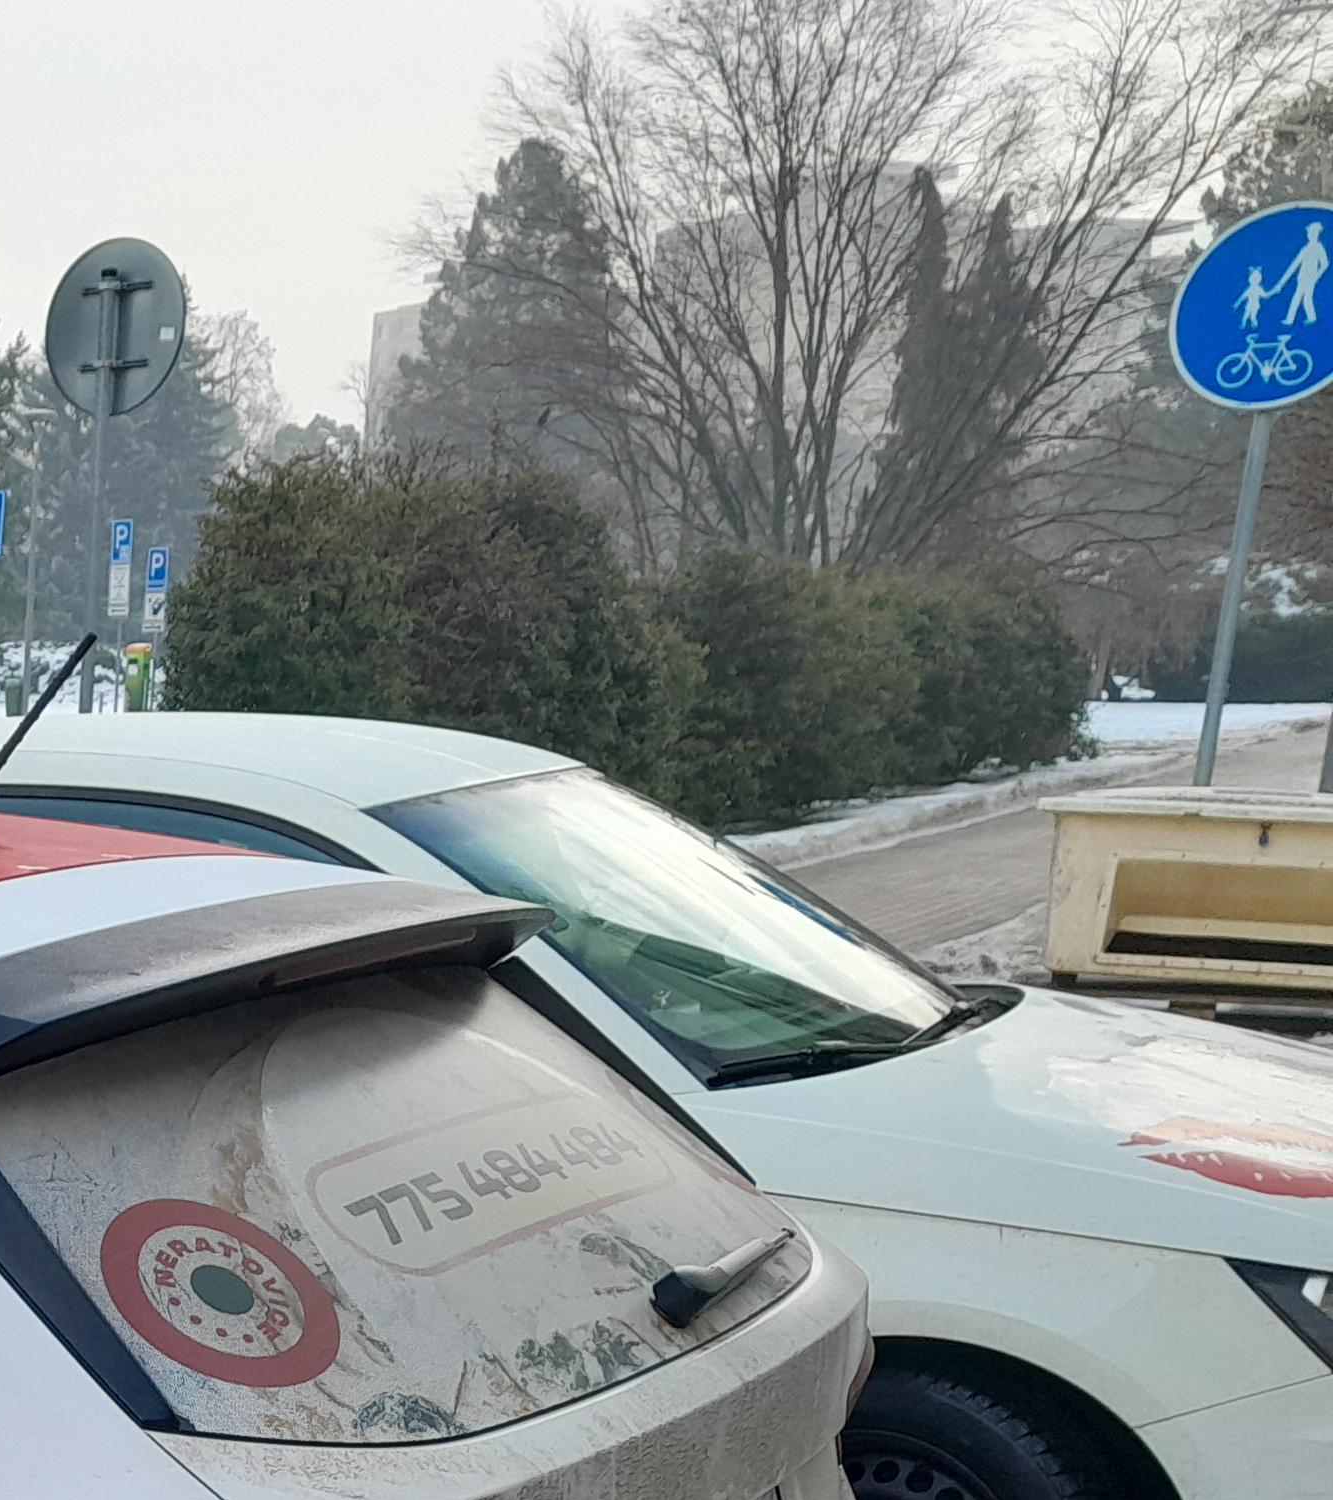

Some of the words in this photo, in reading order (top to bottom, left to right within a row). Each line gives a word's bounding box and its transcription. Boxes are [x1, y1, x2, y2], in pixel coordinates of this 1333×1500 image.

[115, 523, 129, 549] P
[150, 551, 165, 577] P
[343, 1171, 474, 1245] 775
[457, 1143, 569, 1199] 484
[549, 1122, 645, 1171] 484
[153, 1237, 290, 1341] NERATOVICE
